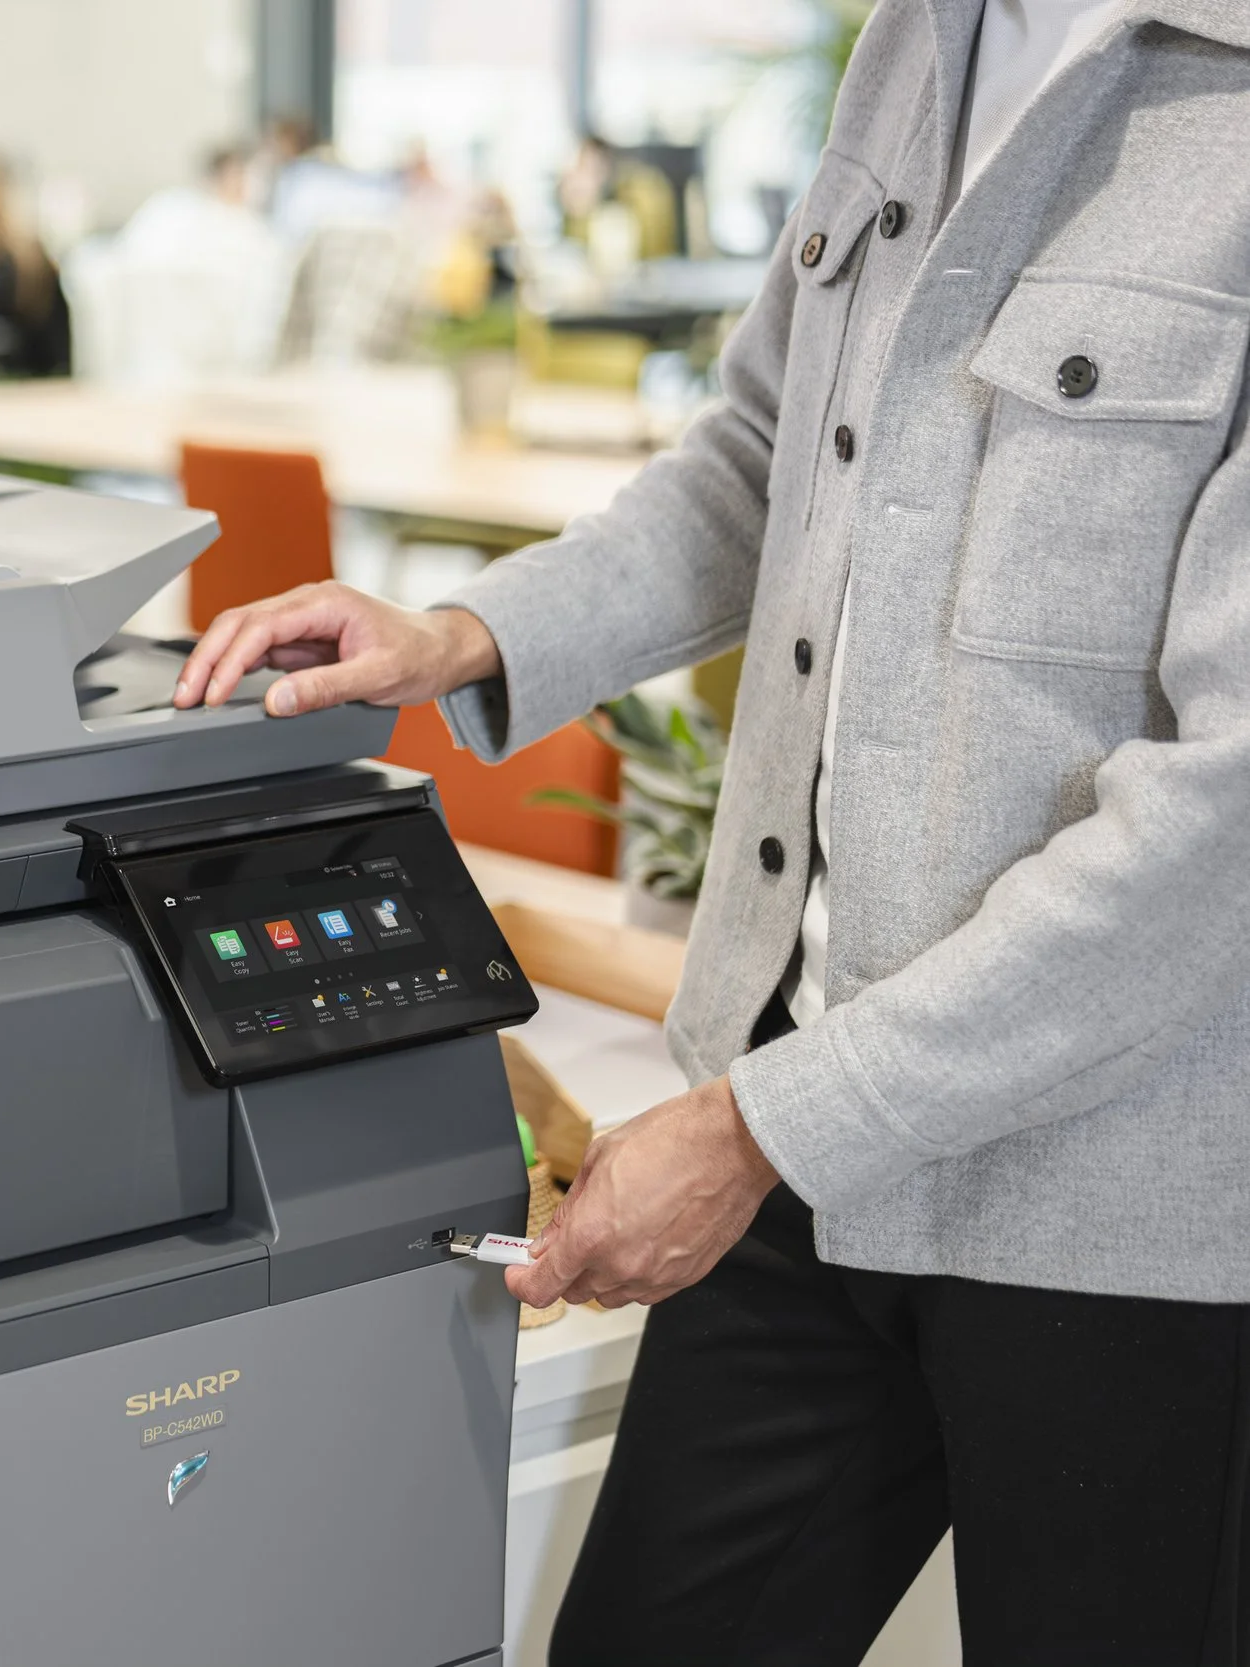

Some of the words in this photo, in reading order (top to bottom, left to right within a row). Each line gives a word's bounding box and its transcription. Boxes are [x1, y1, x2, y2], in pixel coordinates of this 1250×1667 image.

[380, 930, 400, 938] Recent
[286, 949, 299, 957] Easy
[234, 968, 250, 976] Copy
[487, 1238, 528, 1248] SHAR
[125, 1369, 240, 1416] SHARP
[143, 1409, 224, 1443] BP-C542WD
